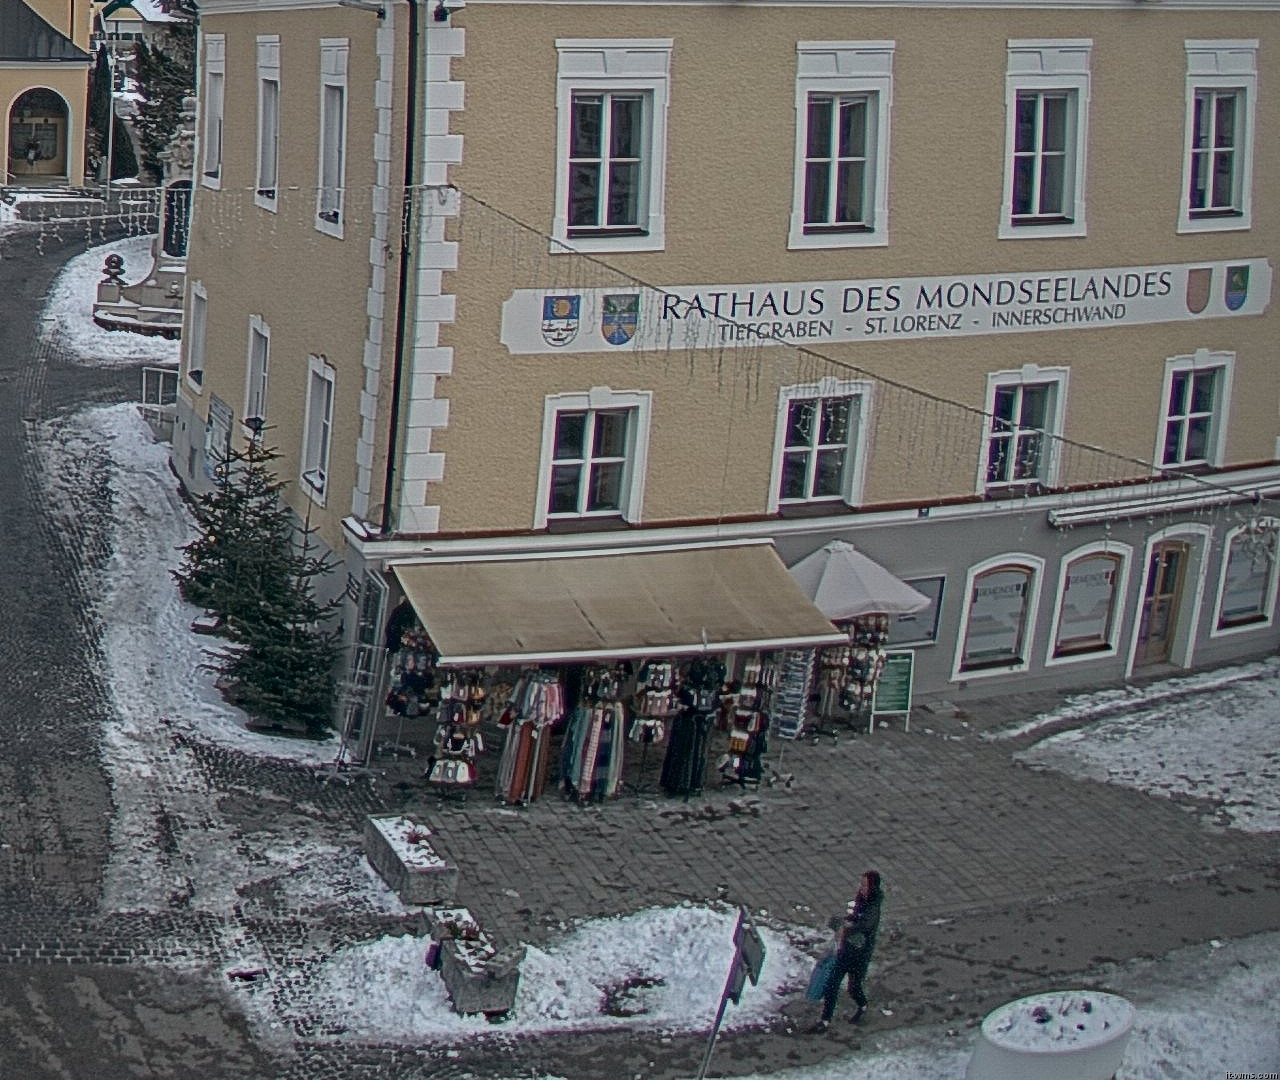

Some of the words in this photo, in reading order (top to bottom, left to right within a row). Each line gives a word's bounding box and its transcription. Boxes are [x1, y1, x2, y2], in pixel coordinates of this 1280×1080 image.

[662, 288, 824, 320] RATHAUS
[842, 285, 901, 314] DES
[916, 271, 1172, 310] MONDSEELANDES
[718, 320, 833, 341] TIEFGRABEN
[864, 317, 888, 334] ST.
[892, 313, 962, 333] LORENZ
[992, 303, 1126, 328] INNERSCHWAND
